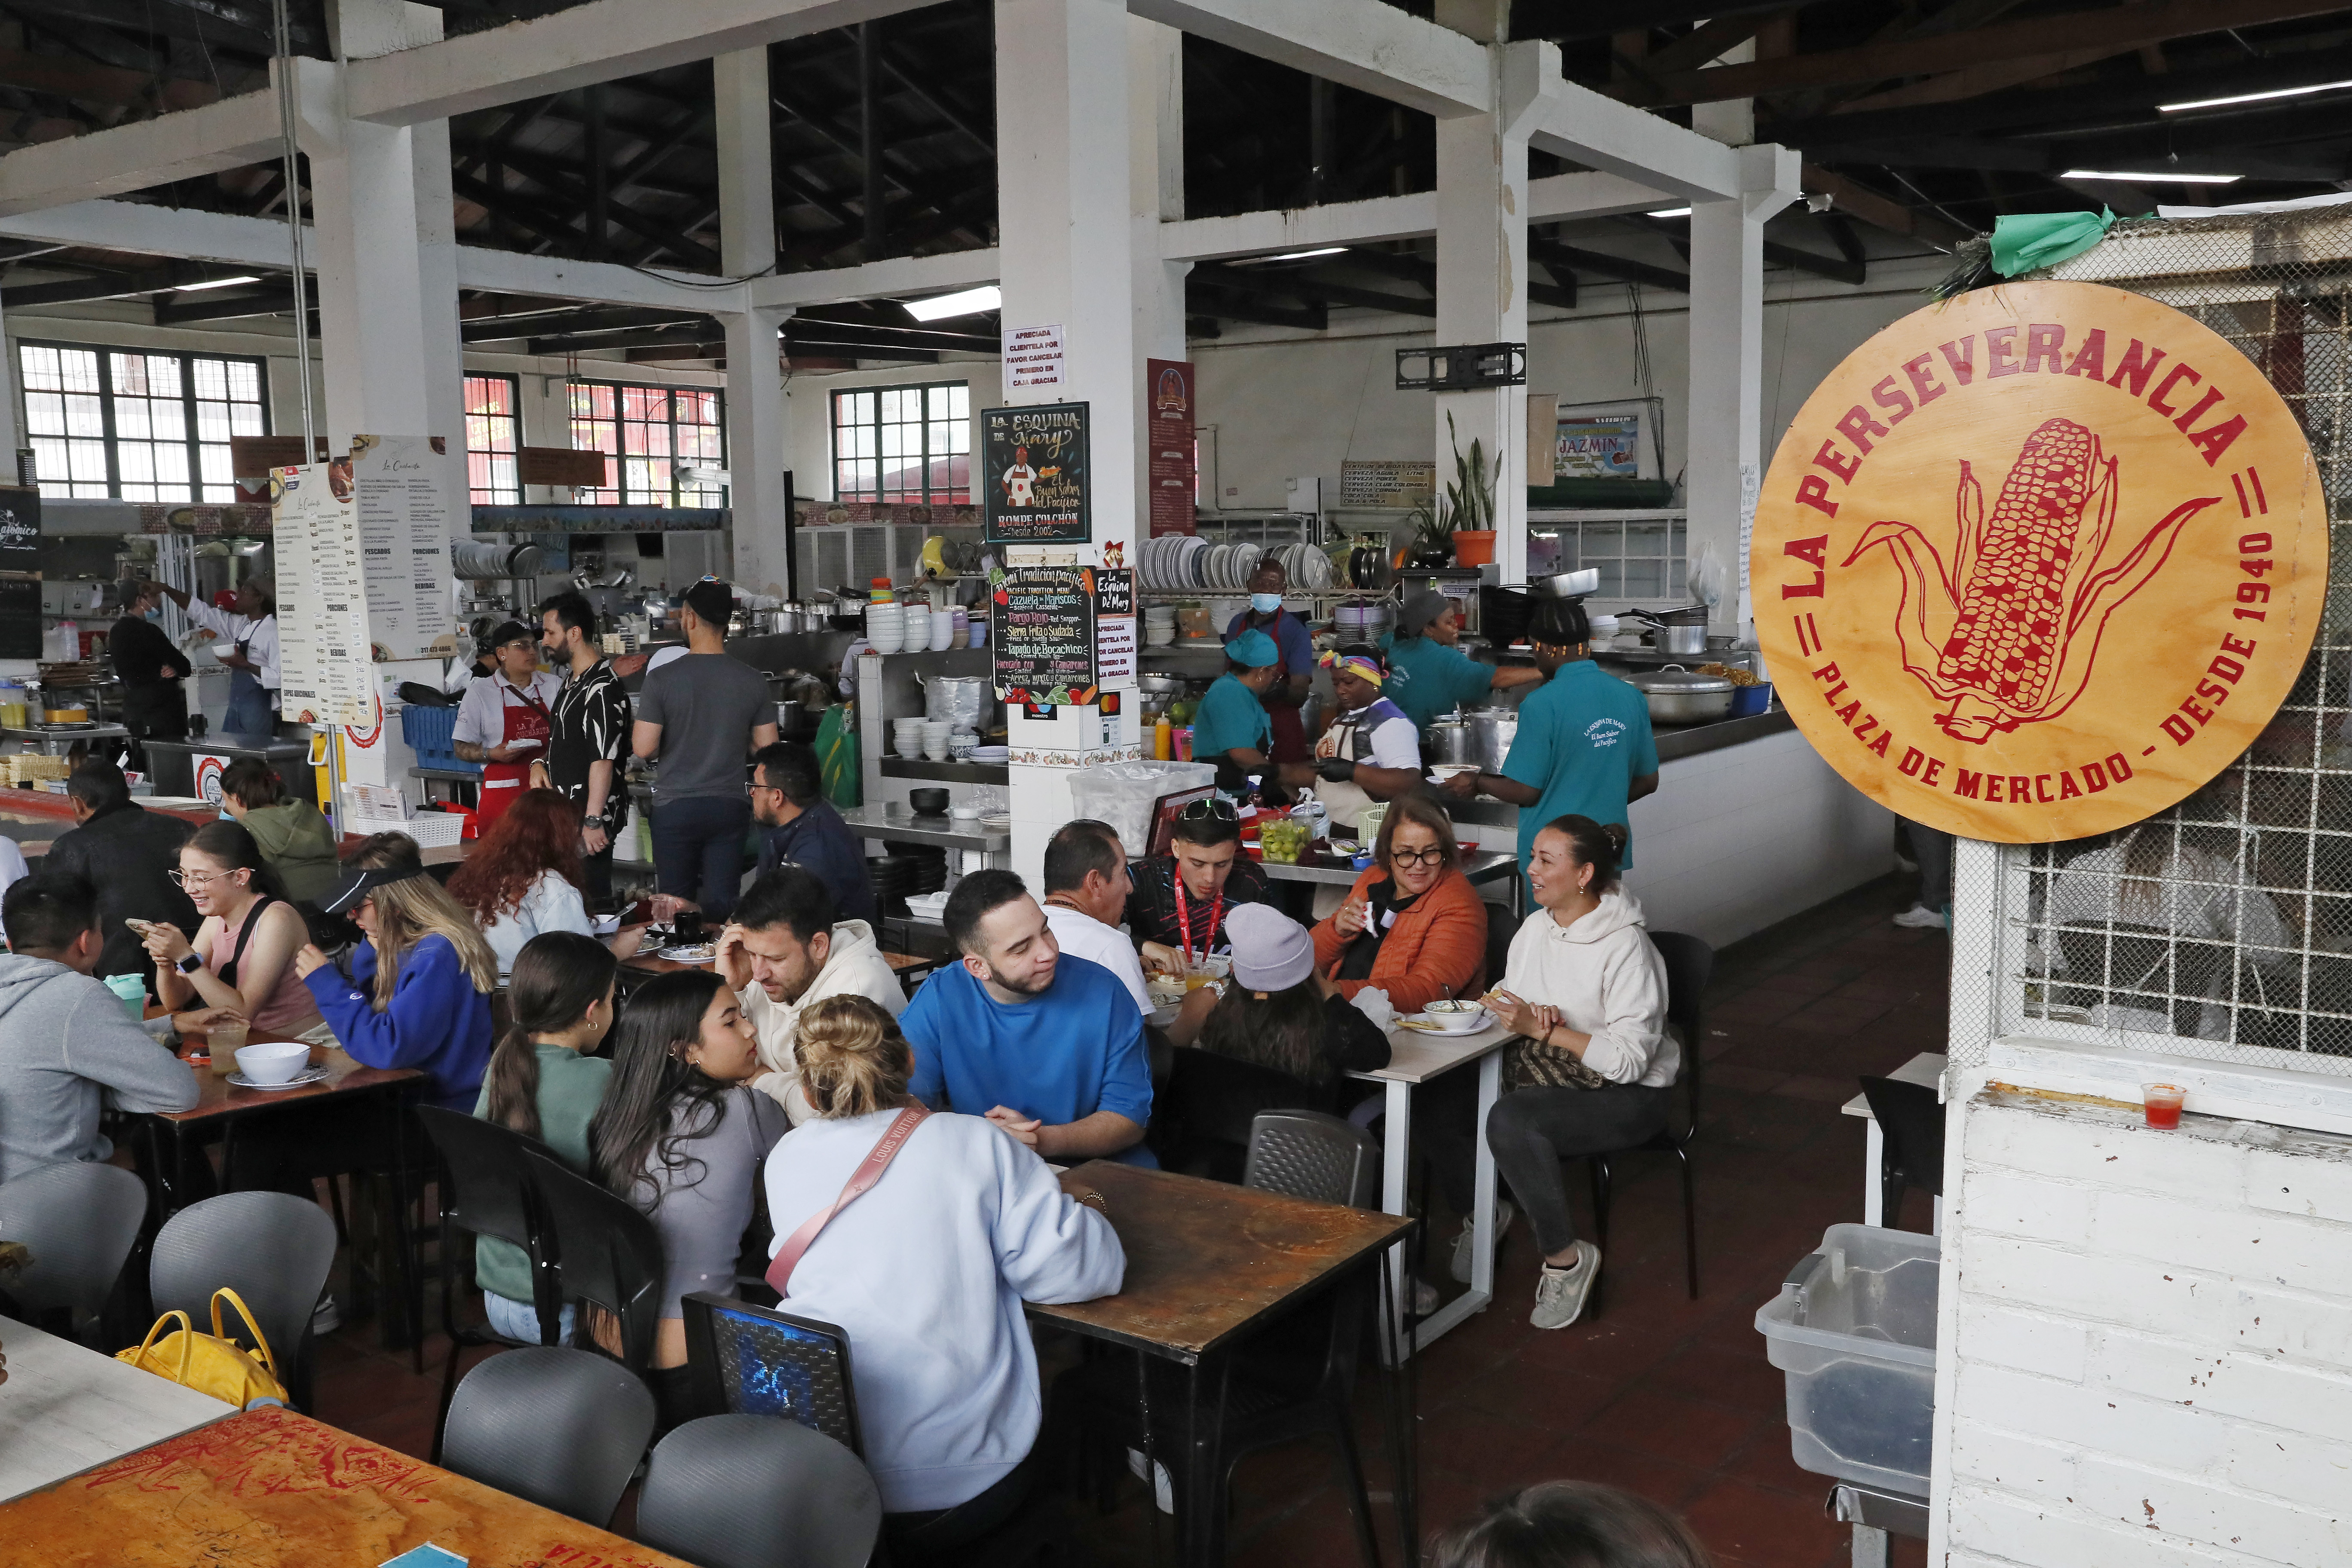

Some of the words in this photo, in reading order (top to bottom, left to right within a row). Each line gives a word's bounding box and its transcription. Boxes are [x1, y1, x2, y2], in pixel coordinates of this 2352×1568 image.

[1016, 330, 1051, 339] APRECIADA
[1010, 343, 1044, 351] CLIENTELA
[1029, 352, 1062, 361] CANCELAR
[1031, 377, 1057, 385] GRACIAS
[991, 416, 1008, 428] LA
[1013, 412, 1081, 431] ESQUINA
[1795, 324, 2248, 518] PERSEVERANCIA
[994, 432, 1004, 441] DE
[1011, 429, 1072, 459] Mary
[1559, 438, 1618, 453] JAZMIN
[1052, 473, 1064, 486] El
[1035, 485, 1057, 497] Buen
[1059, 478, 1081, 496] Sabor
[1033, 494, 1046, 508] del
[998, 515, 1033, 527] ROMPE
[1035, 510, 1078, 524] COLCHÓN
[1008, 526, 1030, 536] Desde
[1034, 526, 1053, 536] 2002
[1782, 534, 1830, 600] LA
[1109, 571, 1116, 582] La
[1098, 577, 1129, 600] Esquina
[1008, 594, 1038, 606] Cazuela
[1044, 594, 1076, 605] Mariscos
[1102, 596, 1110, 608] De
[1112, 594, 1129, 611] Mary
[1008, 612, 1030, 624] Pargo
[1030, 612, 1049, 624] Rojo
[1007, 625, 1026, 637] Sierra
[1029, 625, 1044, 636] Frita
[1049, 624, 1074, 637] Sudada
[1006, 643, 1031, 656] Tapado
[1032, 644, 1041, 654] de
[1041, 644, 1083, 654] Bocachico
[1812, 660, 1887, 756] PLAZA
[1898, 746, 1945, 786] DE
[1953, 751, 2134, 803] MERCADO
[2159, 632, 2257, 748] DESDE
[2233, 532, 2272, 623] 1940
[1055, 674, 1090, 683] Camarones
[1589, 719, 1605, 731] ESQUINA
[1613, 720, 1626, 730] MARY
[516, 727, 550, 739] CUCHARITA
[872, 1140, 896, 1163] LOUIS
[891, 1111, 921, 1138] VUITTON
